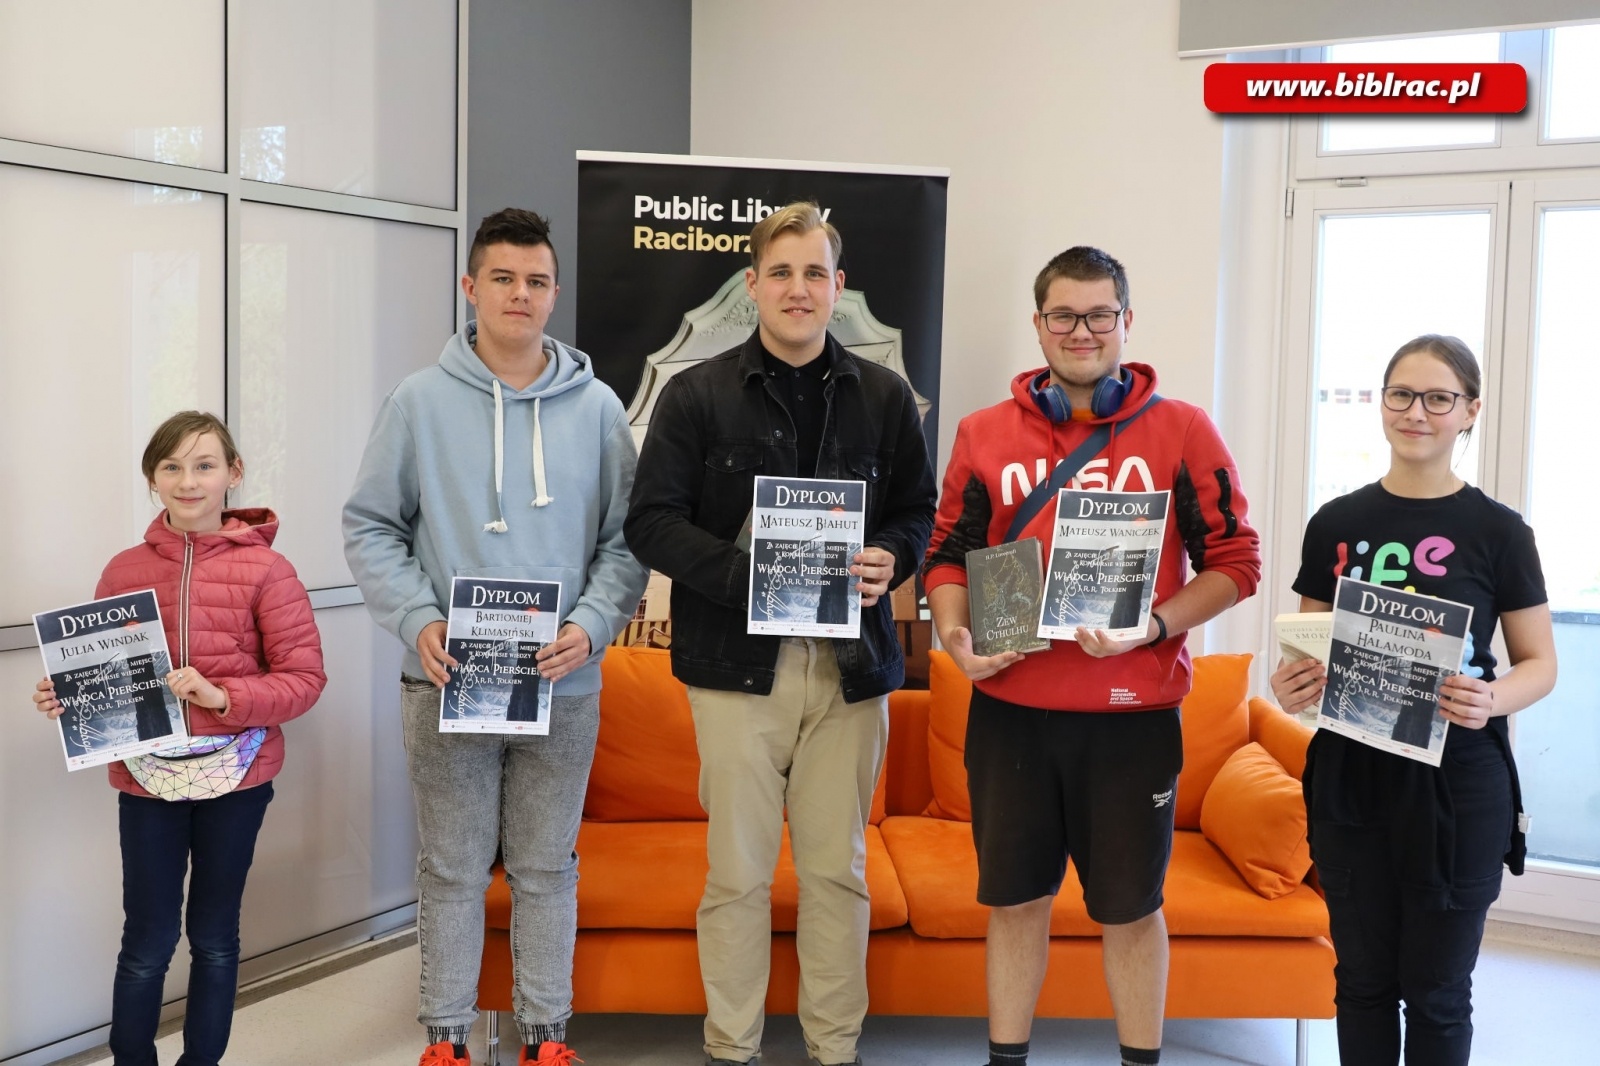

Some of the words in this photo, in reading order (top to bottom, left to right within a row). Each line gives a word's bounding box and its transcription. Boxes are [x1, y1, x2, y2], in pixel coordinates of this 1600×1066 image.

[634, 195, 724, 222] Public
[731, 198, 831, 223] Liby
[1001, 456, 1155, 506] NSA
[775, 485, 846, 507] DYPLOM
[1078, 498, 1151, 518] DYPLOM
[760, 515, 812, 529] MATEUSZ
[1059, 525, 1107, 537] MATEUSZ
[1110, 527, 1160, 537] WANICZEK
[800, 564, 852, 577] PIERŚCIEN
[804, 578, 831, 587] TOLKIEN
[1096, 572, 1152, 585] PIERŚCIENI
[471, 585, 541, 607] DYPLOM
[1101, 585, 1127, 594] TOLKIEN
[1358, 590, 1447, 627] DYPLOM
[58, 604, 139, 638] DYPLOM
[996, 616, 1018, 628] ZEW
[986, 625, 1029, 641] CTHULHU
[1369, 618, 1426, 642] PAULINA
[60, 644, 95, 662] JULIA
[97, 632, 149, 651] WINDAK
[1357, 631, 1432, 661] HALAMODA
[130, 656, 156, 667] MIEJSCA
[121, 667, 145, 676] WIEDZY
[493, 663, 540, 676] PIERŚCIE
[1413, 666, 1442, 678] MIEJSCA
[496, 677, 522, 685] TOLKIEN
[1399, 672, 1427, 683] WIEDZY
[1379, 678, 1441, 702] PIERŚCIEN
[114, 695, 145, 708] TOLKIEN
[1382, 692, 1414, 707] TOLKIEN
